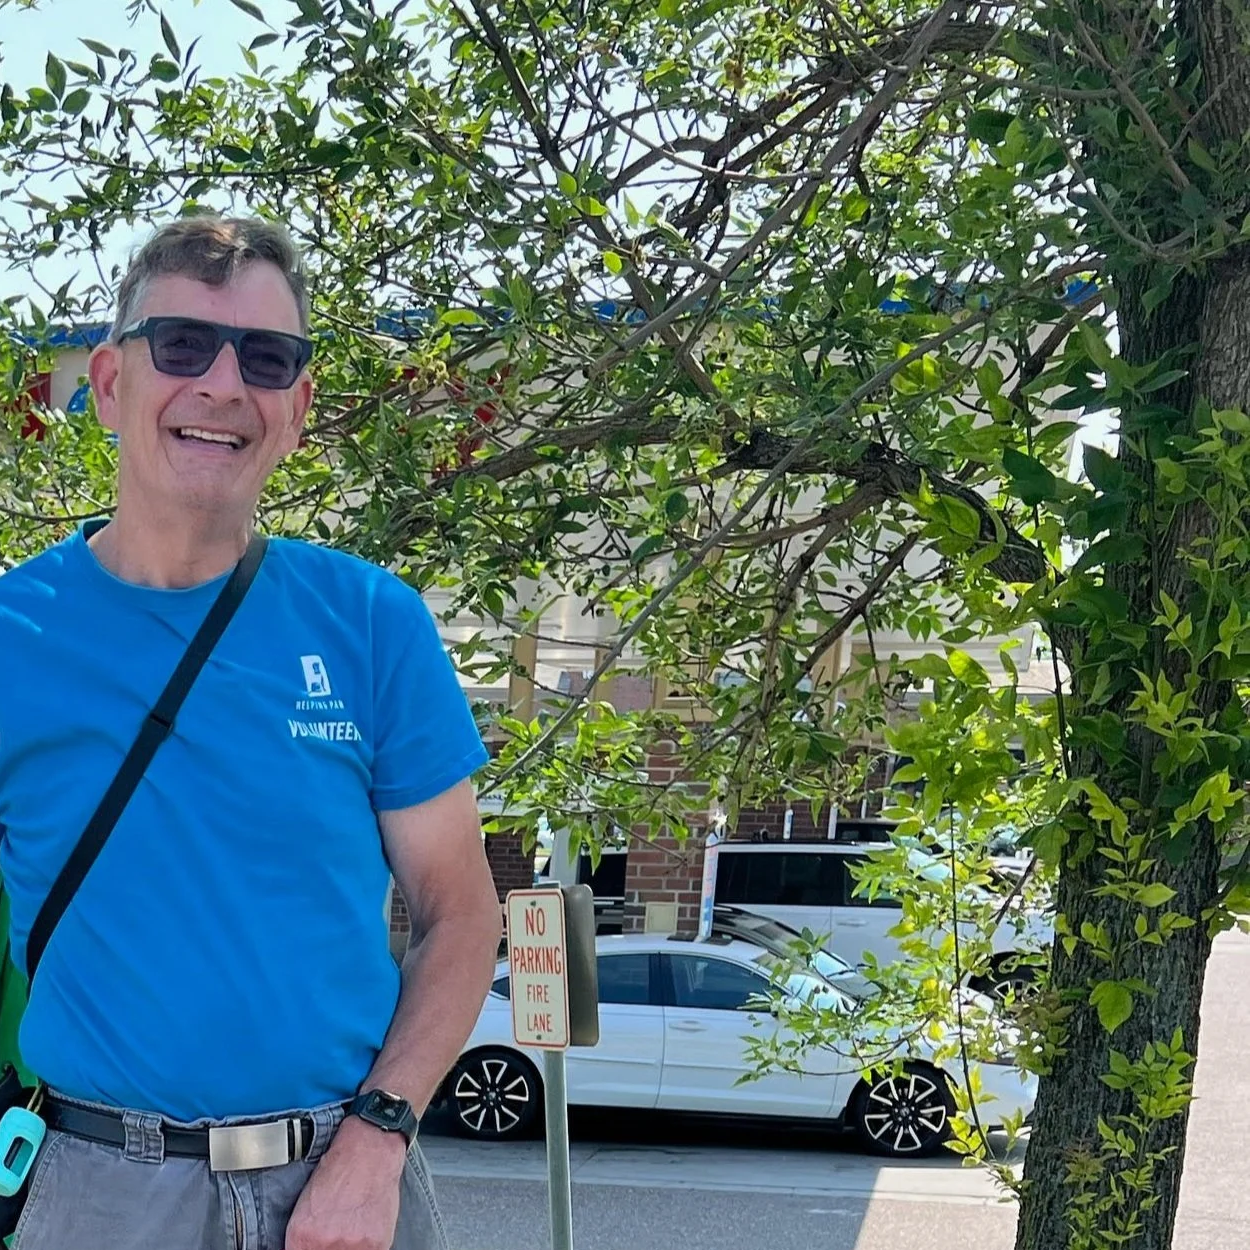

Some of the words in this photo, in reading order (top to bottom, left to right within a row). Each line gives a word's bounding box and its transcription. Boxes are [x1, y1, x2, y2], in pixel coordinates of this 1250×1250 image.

[525, 908, 546, 937] NO
[513, 947, 562, 975] PARKING
[526, 984, 550, 1004] FIRE
[526, 1013, 553, 1033] LANE
